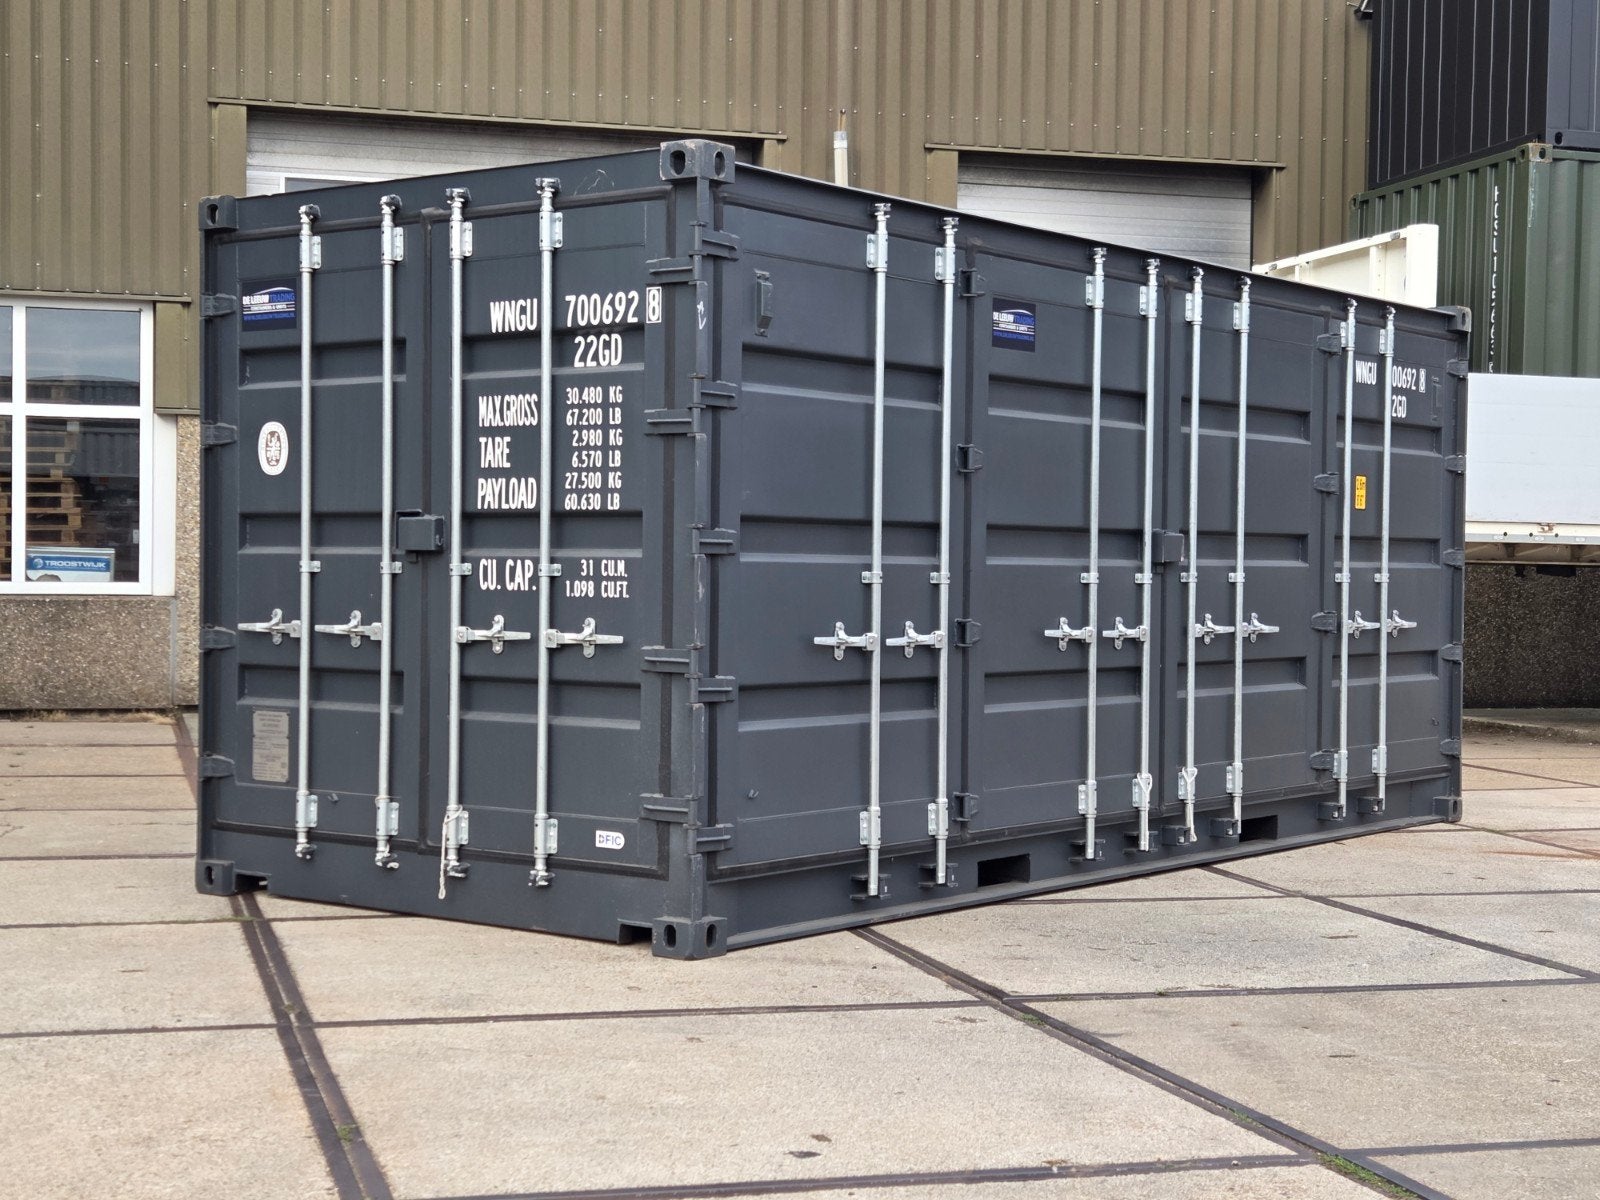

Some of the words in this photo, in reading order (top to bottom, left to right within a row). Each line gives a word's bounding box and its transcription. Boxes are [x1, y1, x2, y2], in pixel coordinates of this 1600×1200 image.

[242, 296, 251, 305] DE
[269, 292, 295, 303] TRADING
[490, 298, 538, 334] WNGU
[565, 290, 639, 328] 700692
[648, 288, 661, 322] 8
[574, 334, 623, 368] 22GD
[1355, 360, 1377, 385] WNGU
[1392, 365, 1417, 390] 00692
[566, 387, 602, 404] 30.480
[609, 386, 622, 403] KG
[478, 394, 538, 427] MAX.GROSS
[1391, 395, 1407, 418] 2GD
[566, 408, 602, 426] 67.200
[609, 407, 622, 424] LB
[572, 430, 602, 446] 2.980
[609, 429, 622, 446] KG
[479, 437, 511, 468] TARE
[572, 451, 602, 467] 6.570
[609, 450, 621, 467] LB
[565, 472, 601, 489] 27.500
[608, 472, 622, 488] KG
[477, 478, 537, 509] PAYLOAD
[564, 493, 601, 510] 60.630
[608, 493, 620, 510] LB
[45, 560, 106, 568] TROOSTWIJK
[581, 559, 593, 576] 31
[601, 560, 628, 577] CU.M.
[479, 559, 501, 590] CU.
[505, 559, 536, 591] CAP.
[565, 580, 594, 598] 1.098
[598, 834, 622, 846] DFIC
